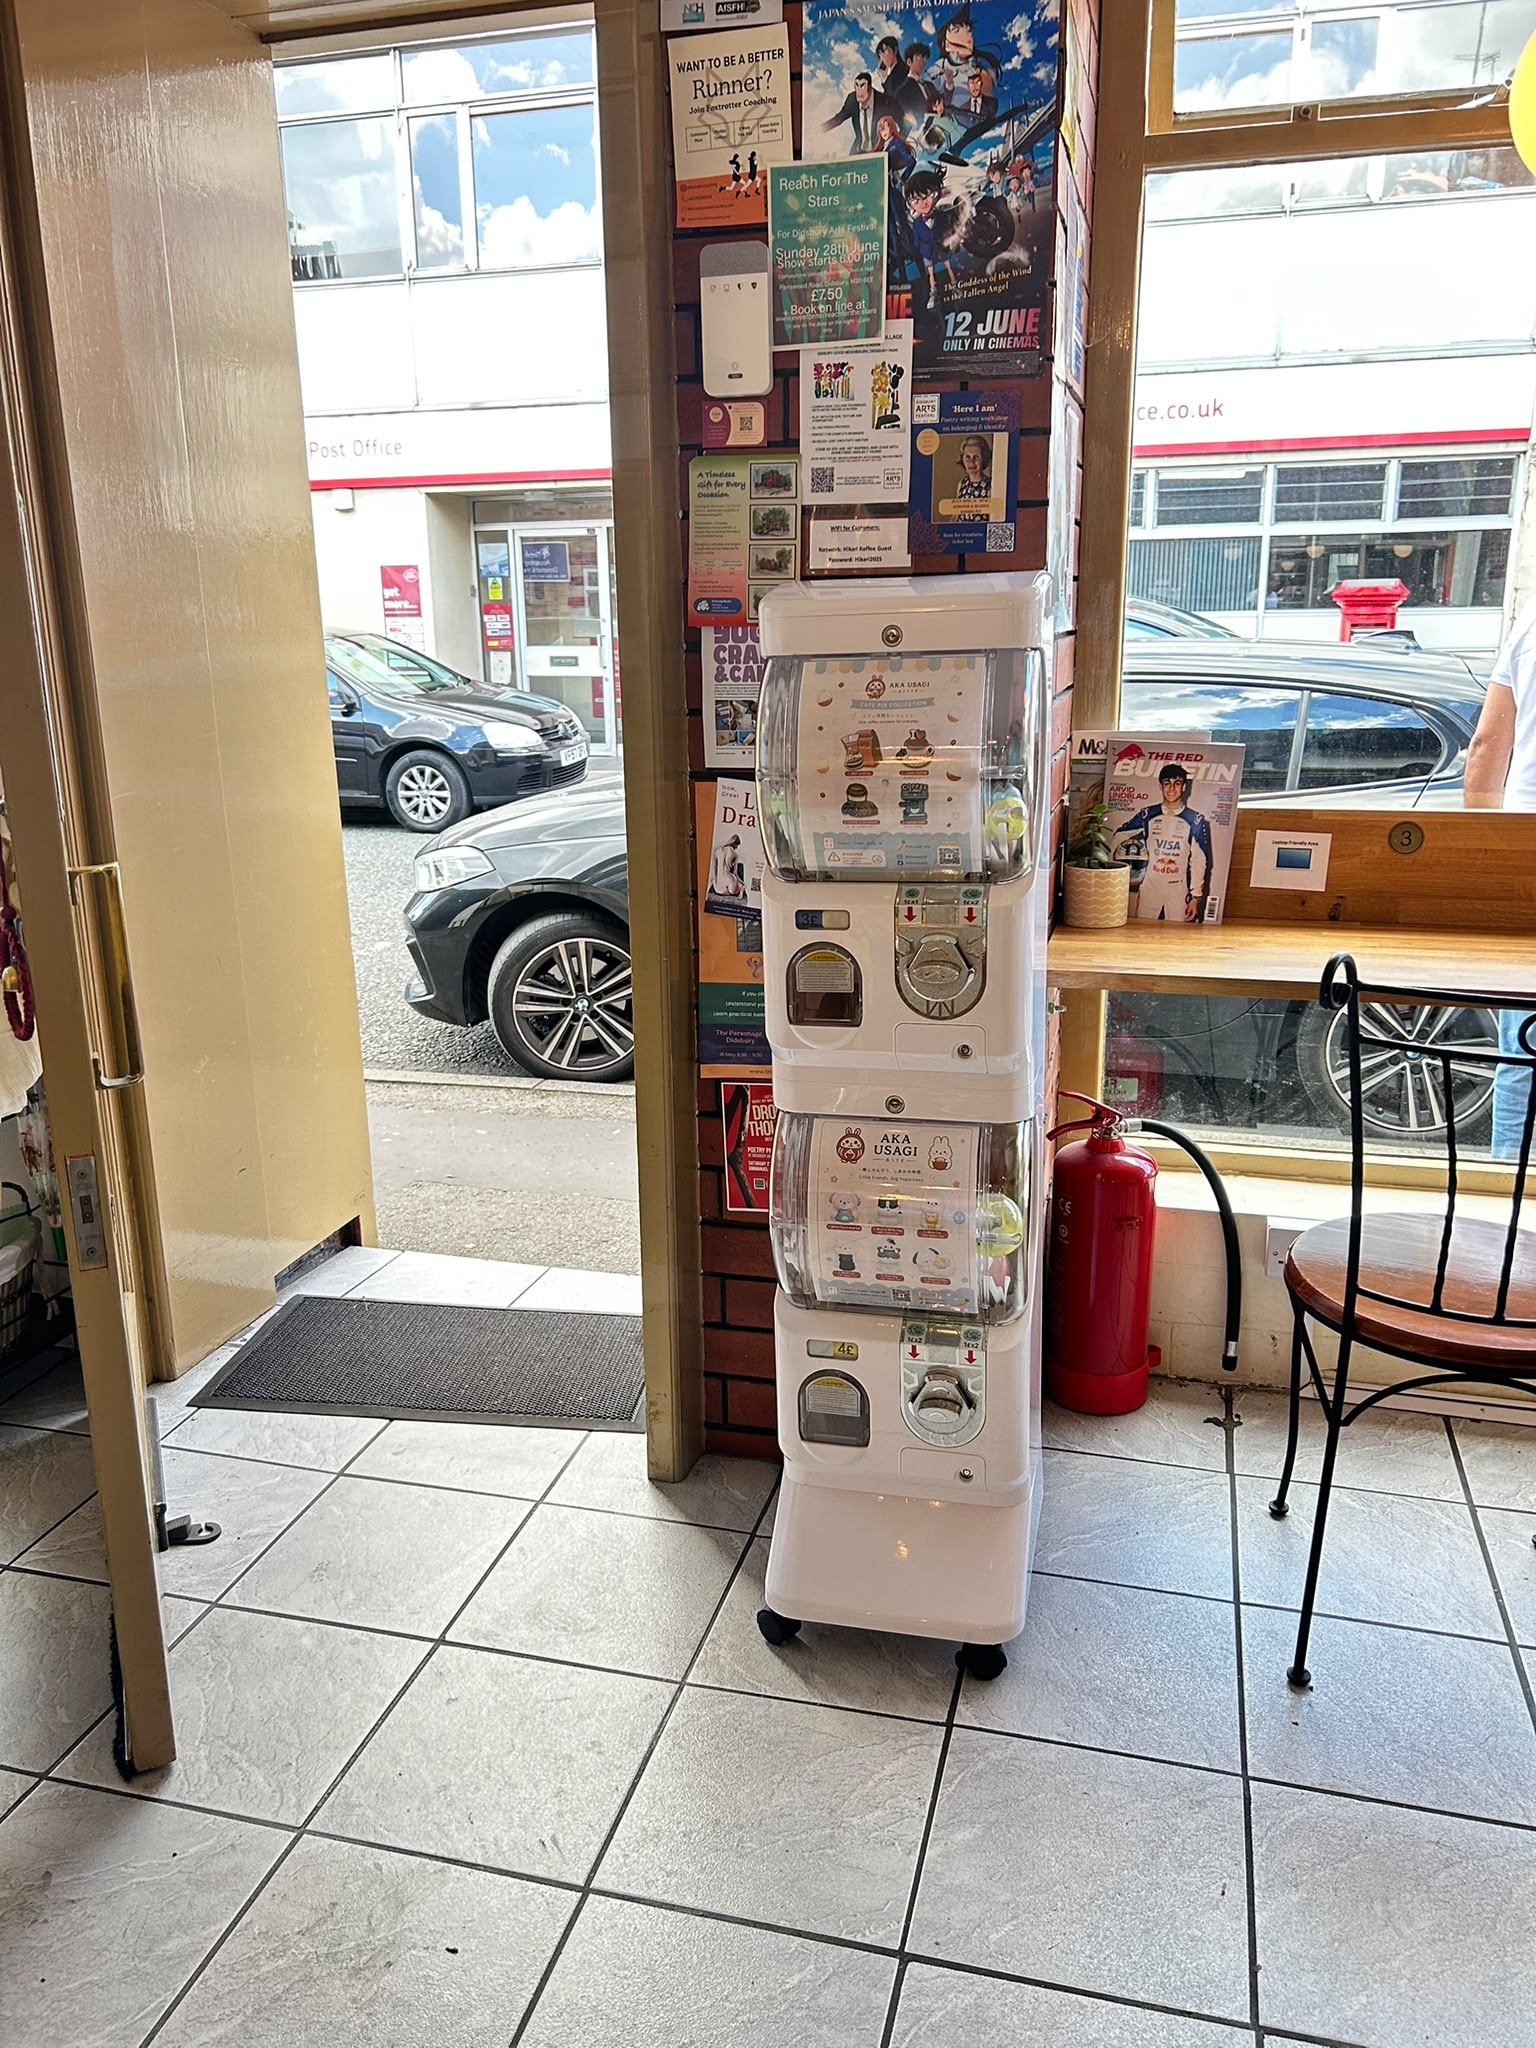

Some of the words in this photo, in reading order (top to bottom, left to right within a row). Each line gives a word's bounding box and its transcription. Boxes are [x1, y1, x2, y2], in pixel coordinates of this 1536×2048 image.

[857, 4, 889, 15] SMASH
[912, 0, 931, 8] BOX
[677, 60, 705, 73] WANT
[708, 58, 721, 69] TO
[724, 55, 736, 67] BE
[738, 54, 746, 65] A
[748, 48, 784, 63] BETTER
[693, 69, 772, 100] Runner?
[689, 106, 705, 115] Join
[706, 102, 741, 112] Foxtrotter
[743, 96, 777, 108] Coaching
[779, 176, 818, 191] Reach
[822, 174, 842, 187] For
[845, 171, 868, 184] The
[808, 195, 840, 207] Stars
[777, 231, 790, 239] For
[792, 226, 827, 238] Didsbury
[829, 226, 846, 234] Arts
[847, 222, 877, 233] Festival
[776, 245, 820, 261] Sunday
[823, 243, 849, 256] 28th
[851, 241, 880, 253] June
[777, 257, 806, 269] Show
[808, 255, 837, 266] starts
[840, 252, 861, 263] 6.00
[863, 252, 880, 263] pm
[944, 282, 956, 291] The
[957, 276, 988, 288] Goddess
[989, 272, 998, 282] of
[998, 270, 1010, 280] the
[1012, 265, 1032, 276] Wind
[811, 287, 843, 302] £7.50
[951, 291, 962, 301] the
[963, 287, 986, 298] Fallen
[987, 281, 1009, 294] Angel
[791, 303, 817, 315] Book
[819, 303, 832, 312] on
[855, 300, 866, 310] at
[944, 311, 973, 337] 12
[976, 308, 1041, 335] JUNE
[943, 338, 970, 351] ONLY
[973, 338, 985, 350] IN
[988, 335, 1039, 349] CINEMAS
[915, 405, 936, 413] ARTS
[1136, 398, 1223, 420] ce.co.uk
[309, 441, 346, 459] Post
[353, 438, 402, 457] Office
[705, 470, 735, 478] Timeless
[697, 480, 713, 489] Gift
[713, 480, 725, 489] for
[726, 481, 746, 490] Every
[697, 490, 730, 498] Occasion
[713, 645, 766, 665] CRA
[1078, 739, 1107, 754] M&
[1147, 752, 1174, 760] THE
[1175, 753, 1203, 762] RED
[1155, 839, 1181, 850] VISA
[1400, 830, 1412, 847] 3
[801, 913, 818, 926] 3£
[725, 1037, 756, 1045] Didsbury
[880, 1134, 911, 1144] AKA
[873, 1144, 918, 1156] USAGI
[837, 1343, 854, 1355] 4£
